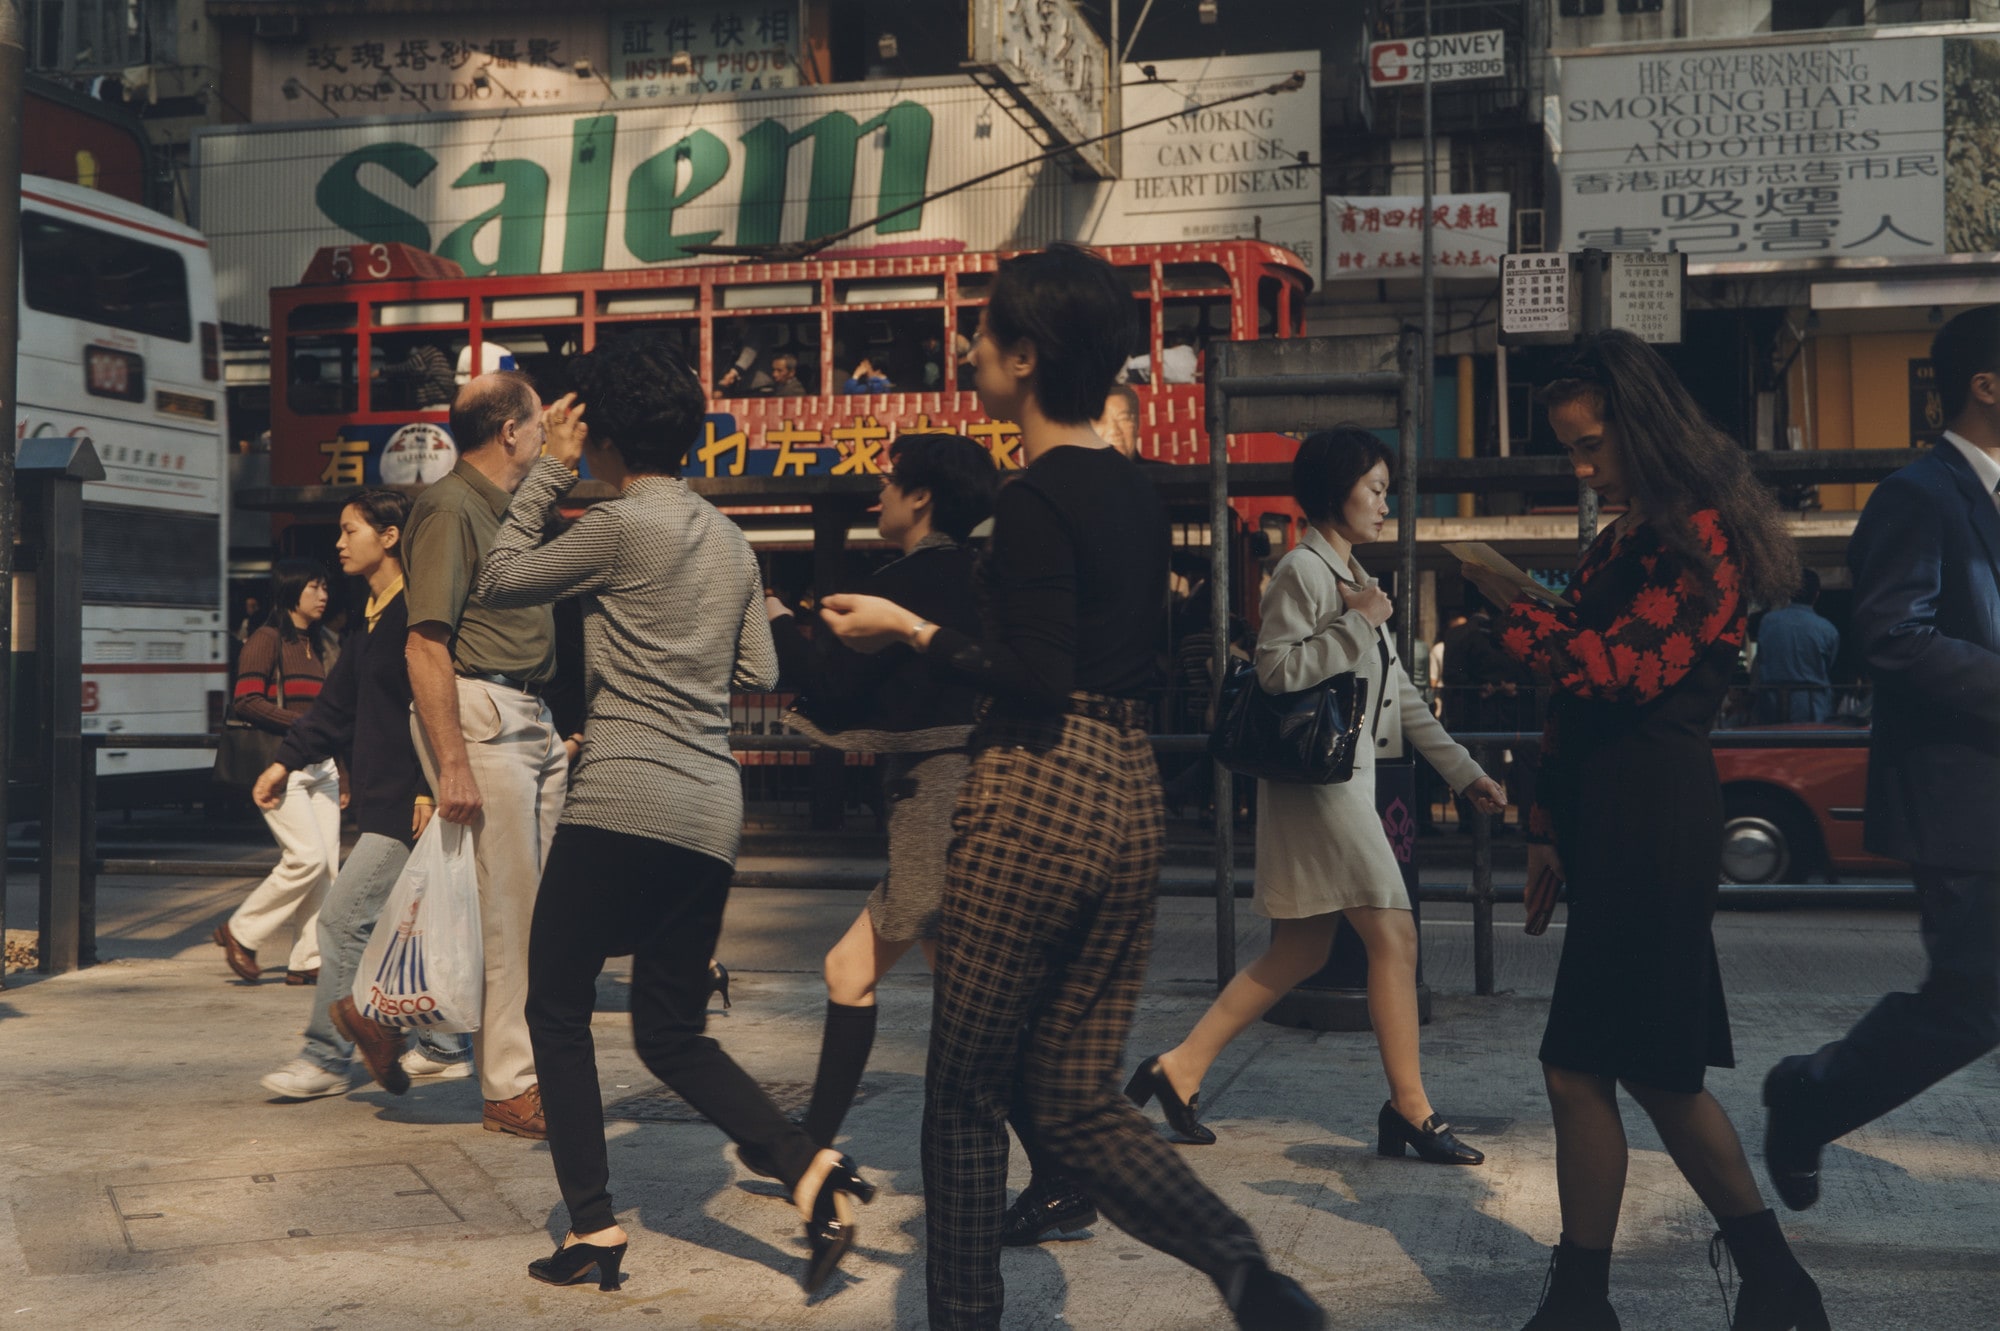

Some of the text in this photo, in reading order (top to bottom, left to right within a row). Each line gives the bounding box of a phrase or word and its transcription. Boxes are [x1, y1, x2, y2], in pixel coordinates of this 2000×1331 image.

[1413, 34, 1500, 59] CONVEY
[1413, 59, 1501, 80] 239 3806
[1639, 49, 1860, 78] HK GOVERNMENT
[400, 80, 492, 102] STUDIO
[1639, 64, 1869, 95] HEALTH WARNING
[1567, 79, 1940, 122] SMOKING HARMS
[1167, 108, 1274, 135] SMOKING
[1649, 108, 1860, 139] YOURSELF
[1157, 138, 1285, 167] CAN CAUSE
[1624, 129, 1880, 163] AND OTHERS
[316, 100, 934, 277] salem
[1135, 168, 1309, 199] HEART DISEASE
[1572, 155, 1939, 194] 香港政府忠告市民
[1662, 185, 1843, 221] 吸煙
[1577, 215, 1934, 254] 害己害人
[331, 243, 392, 279] 53
[320, 436, 370, 486] 有
[371, 986, 436, 1015] TESCO
